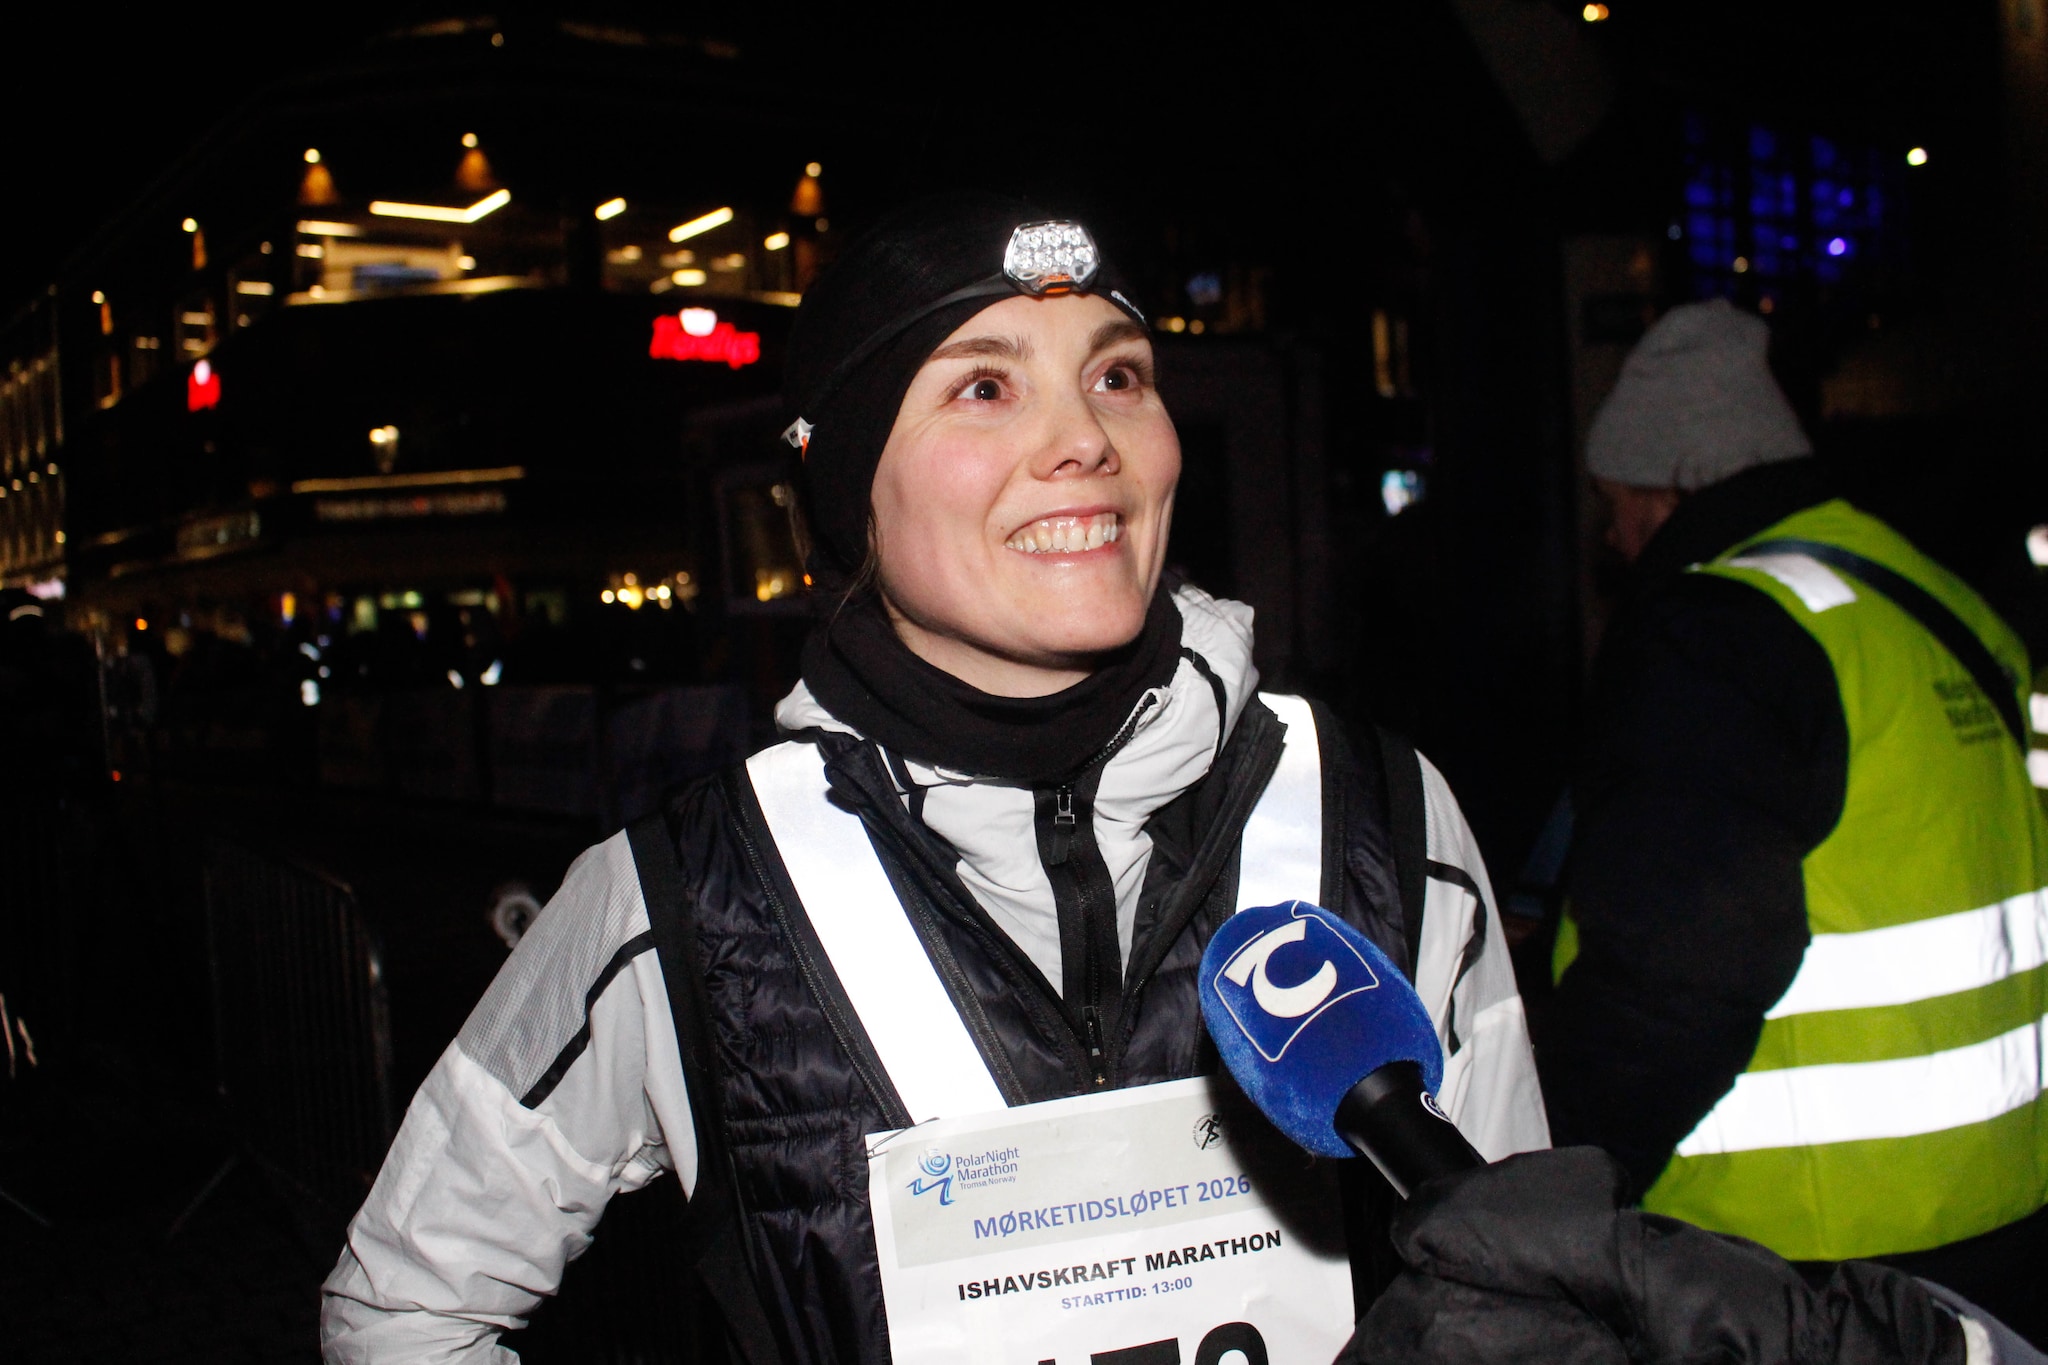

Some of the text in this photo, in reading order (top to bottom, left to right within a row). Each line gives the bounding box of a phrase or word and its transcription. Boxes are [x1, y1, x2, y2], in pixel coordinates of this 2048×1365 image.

[955, 1147, 1020, 1168] PolarNight
[957, 1162, 1018, 1182] Marathon
[988, 1175, 1016, 1186] Norway
[973, 1174, 1250, 1239] MØRKETIDSLØPET 2026
[958, 1230, 1281, 1300] ISHAVSKRAFT MARATHON
[1061, 1276, 1193, 1310] STARTTID: 13:00
